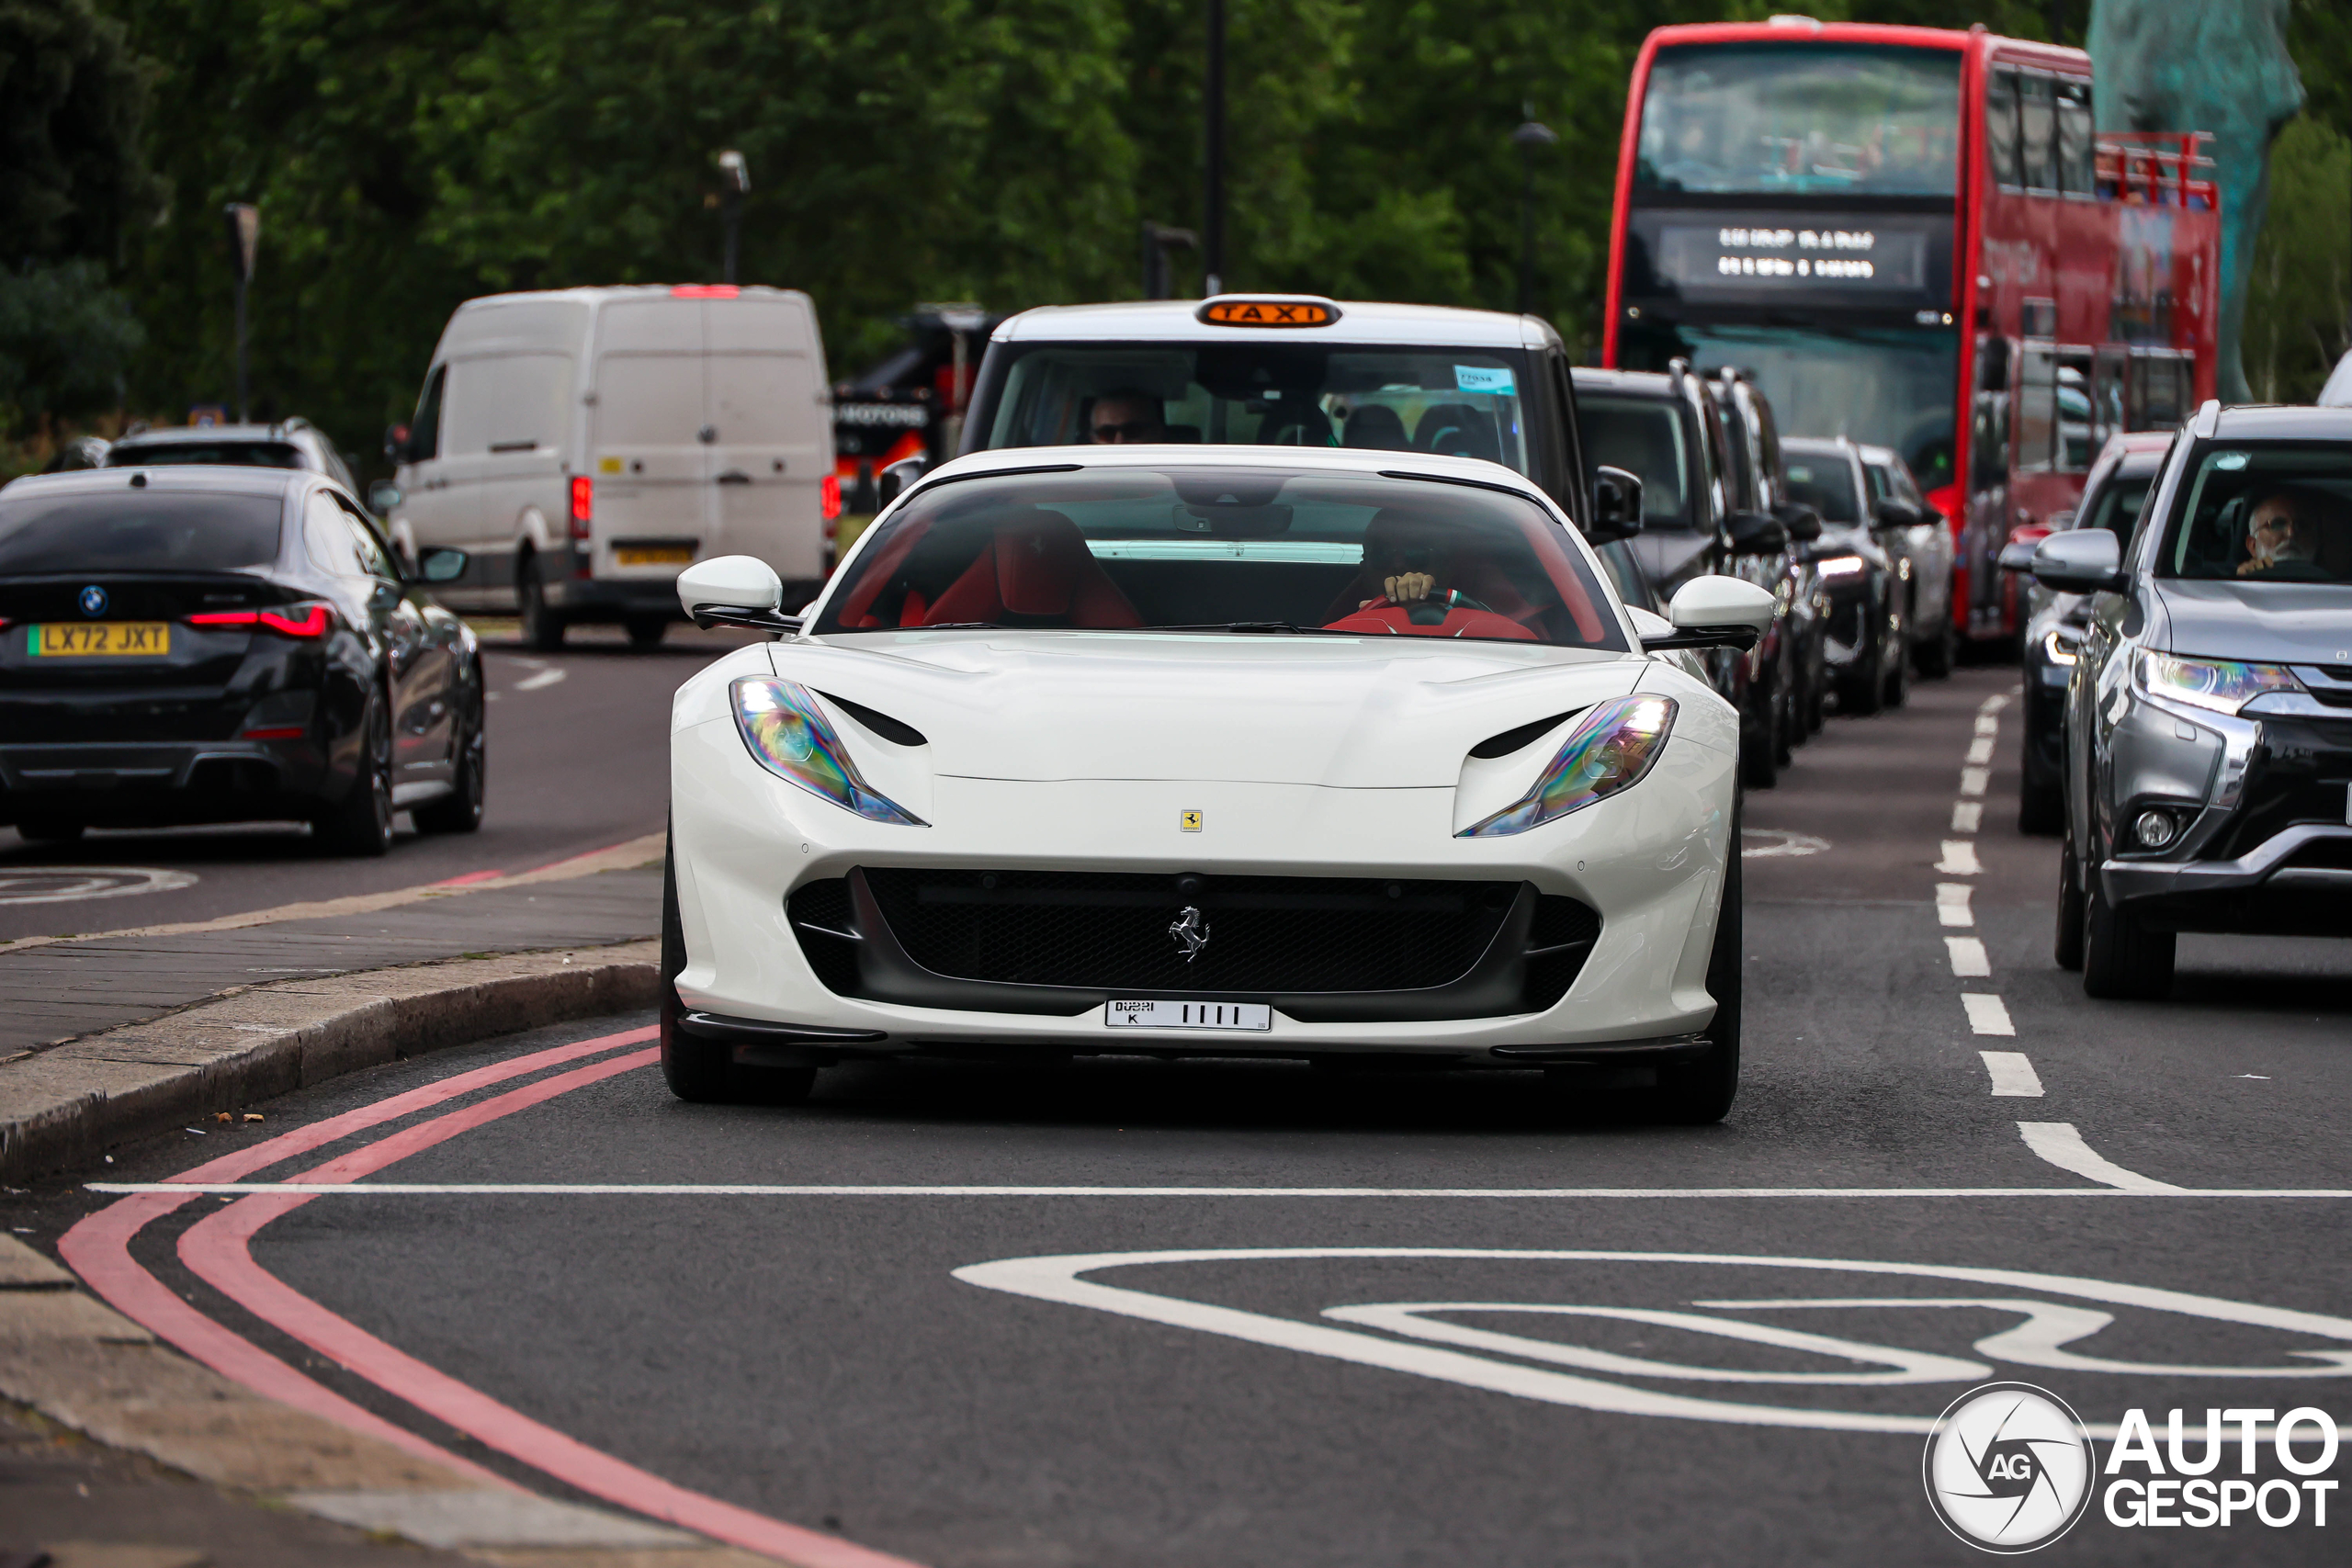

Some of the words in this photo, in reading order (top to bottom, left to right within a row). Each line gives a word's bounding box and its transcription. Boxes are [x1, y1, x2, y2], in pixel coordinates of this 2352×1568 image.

[1221, 305, 1314, 321] TAXI
[44, 625, 107, 651] LX72
[118, 625, 163, 649] JXT
[1128, 1013, 1138, 1024] K
[1182, 1004, 1239, 1025] 1111
